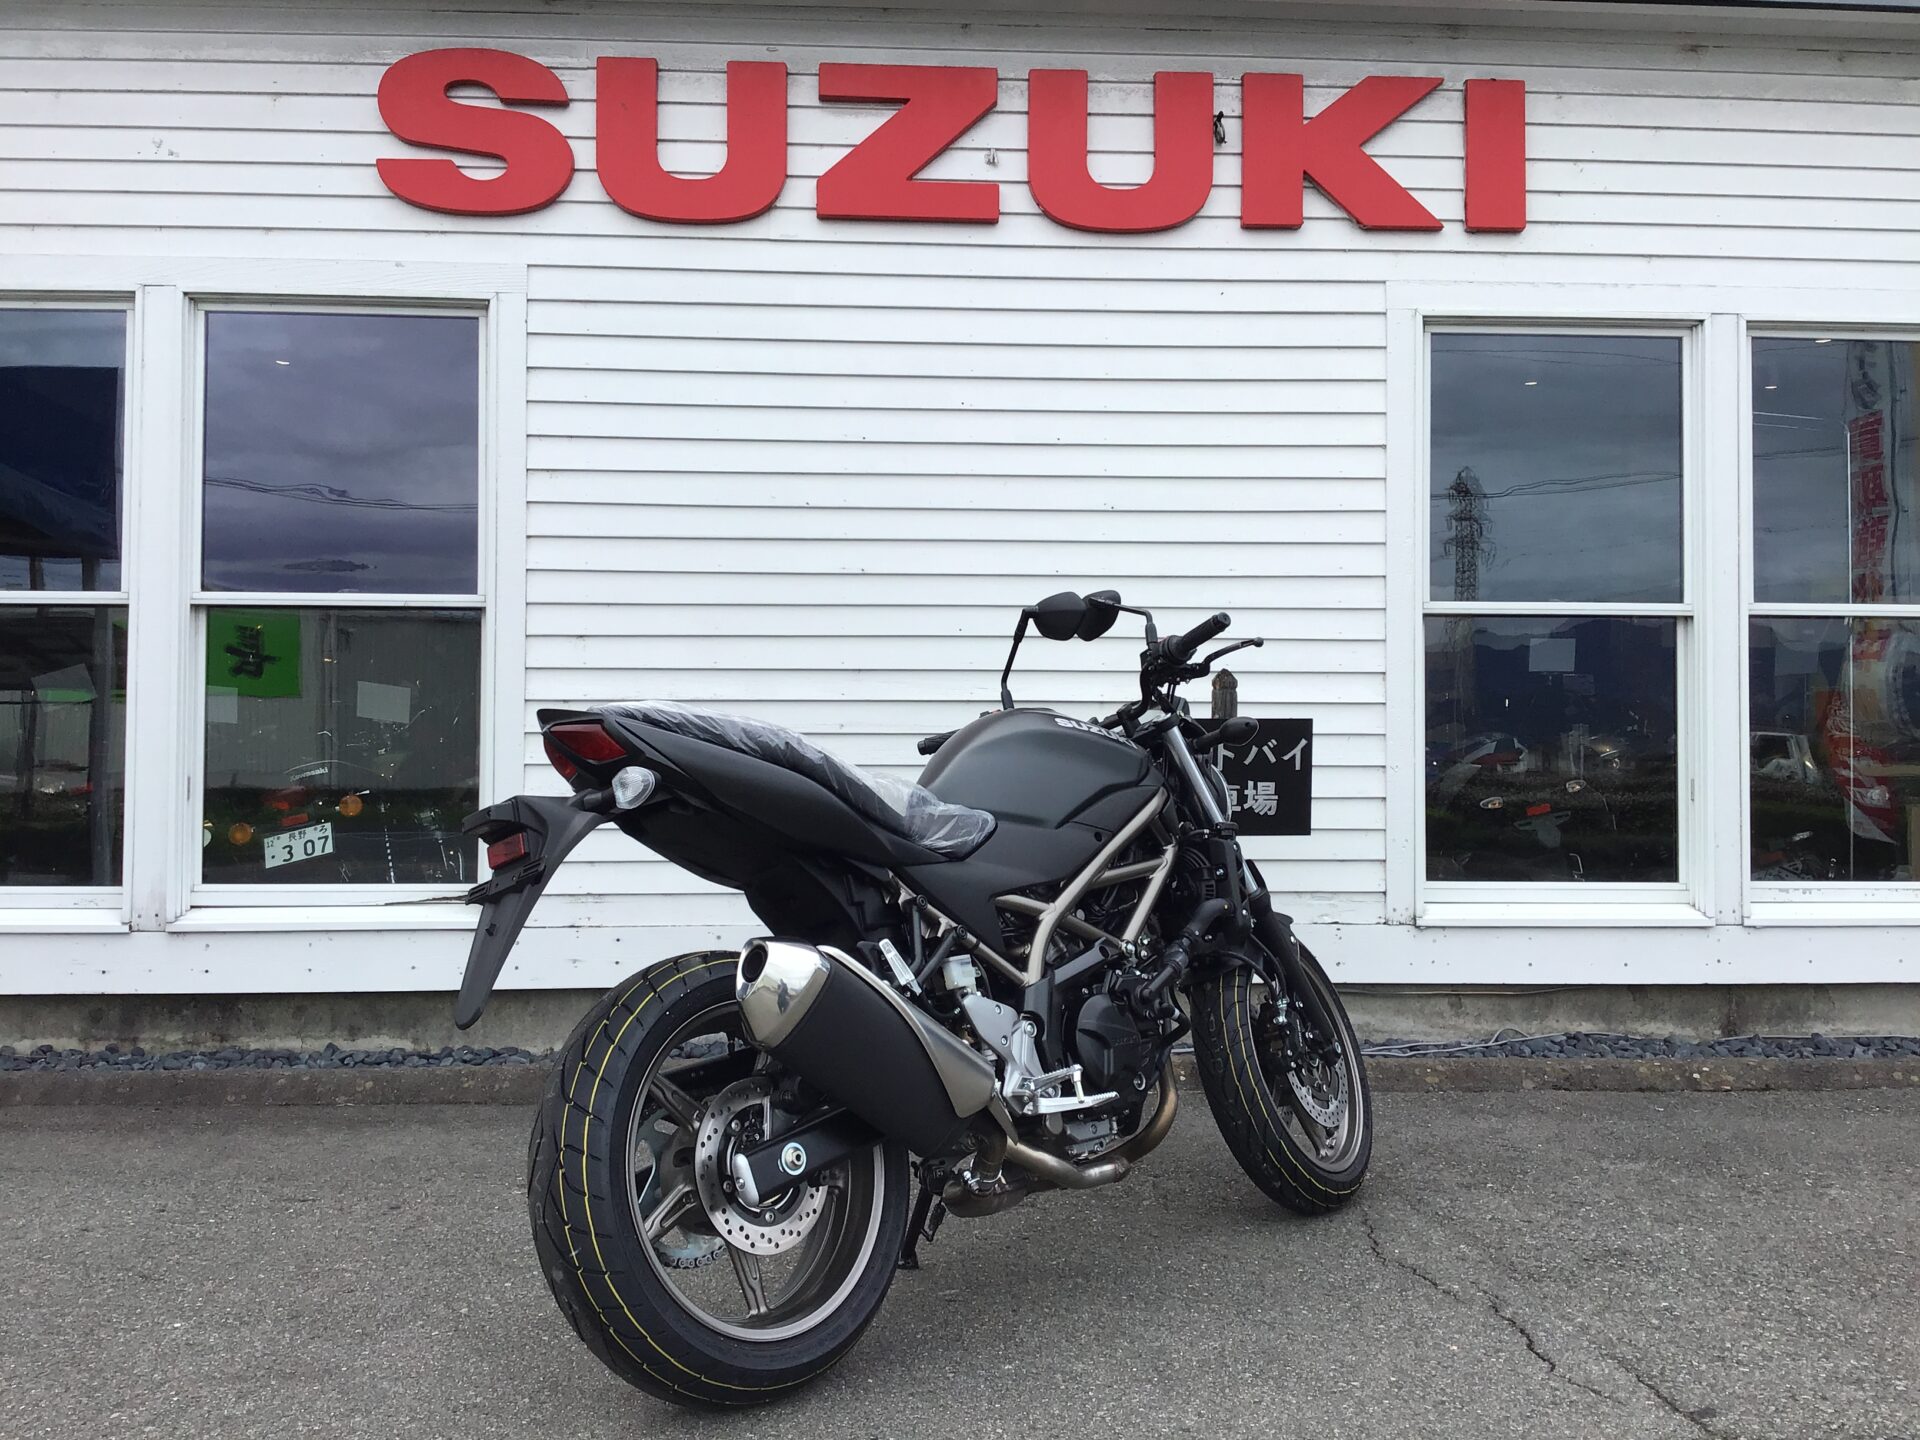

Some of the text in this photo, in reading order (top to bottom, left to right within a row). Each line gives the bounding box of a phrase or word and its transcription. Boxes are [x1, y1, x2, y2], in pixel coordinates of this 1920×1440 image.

[376, 48, 1527, 234] SUZUKI
[1217, 738, 1308, 771] トバイ
[289, 766, 329, 783] Kawasaki
